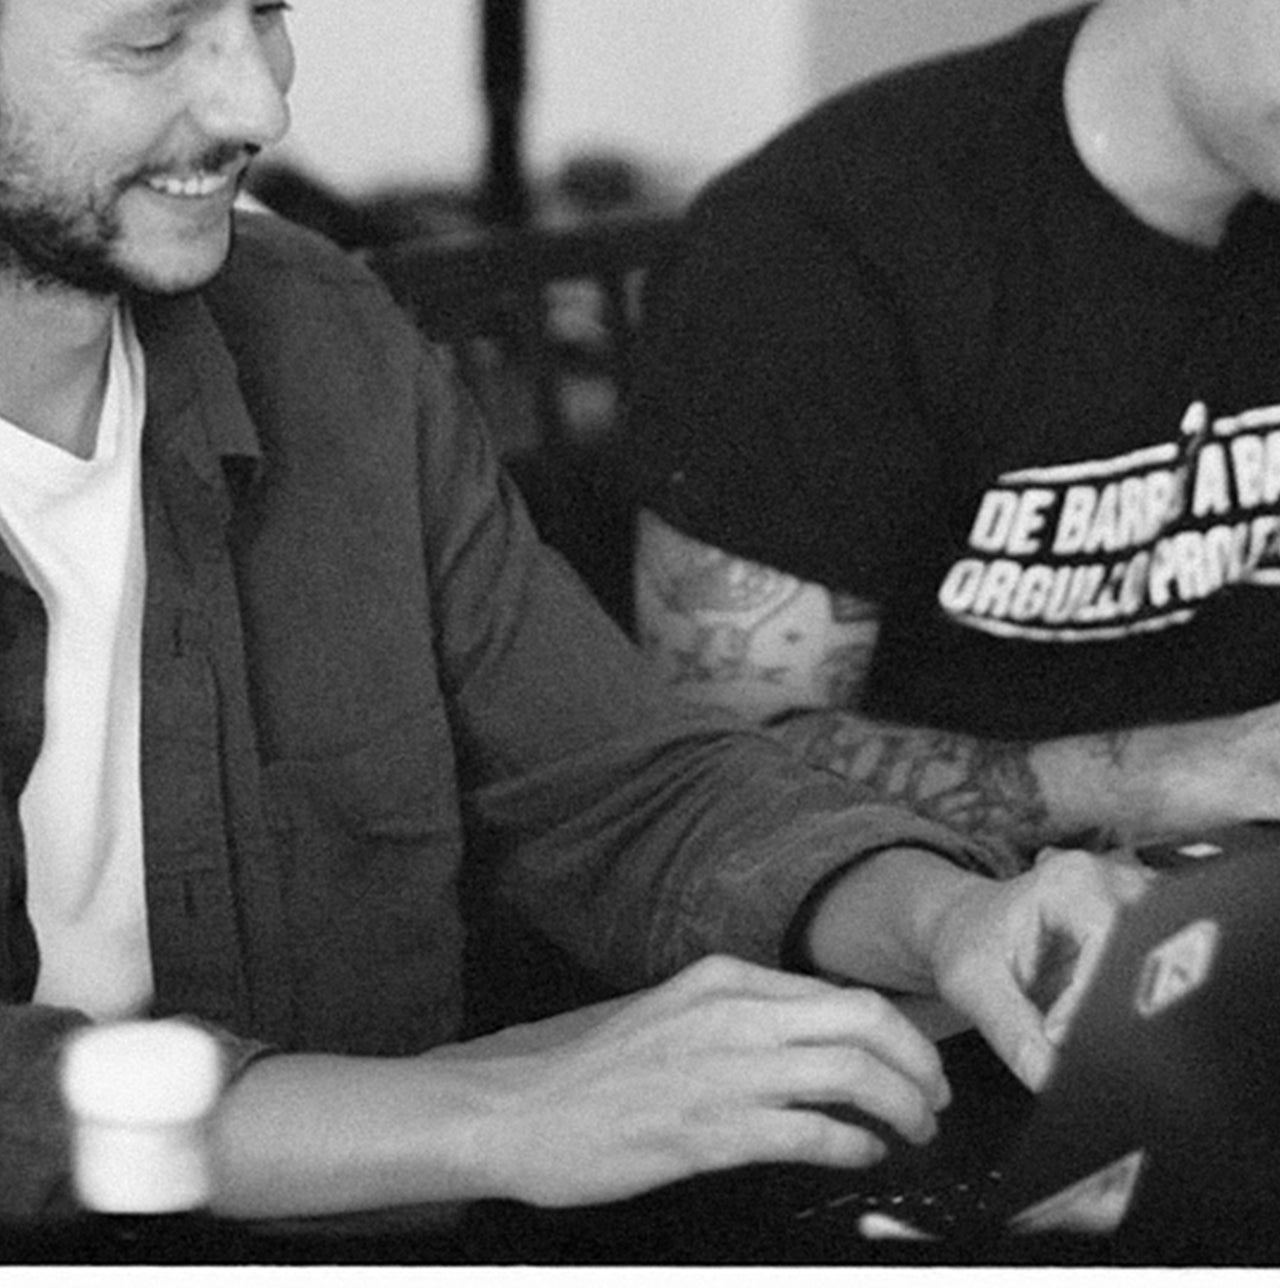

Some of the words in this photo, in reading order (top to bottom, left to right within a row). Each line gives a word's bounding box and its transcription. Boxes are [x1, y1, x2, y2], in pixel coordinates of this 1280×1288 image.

[969, 488, 1056, 555] DE
[1052, 469, 1188, 555] BARR
[1192, 443, 1231, 517] A
